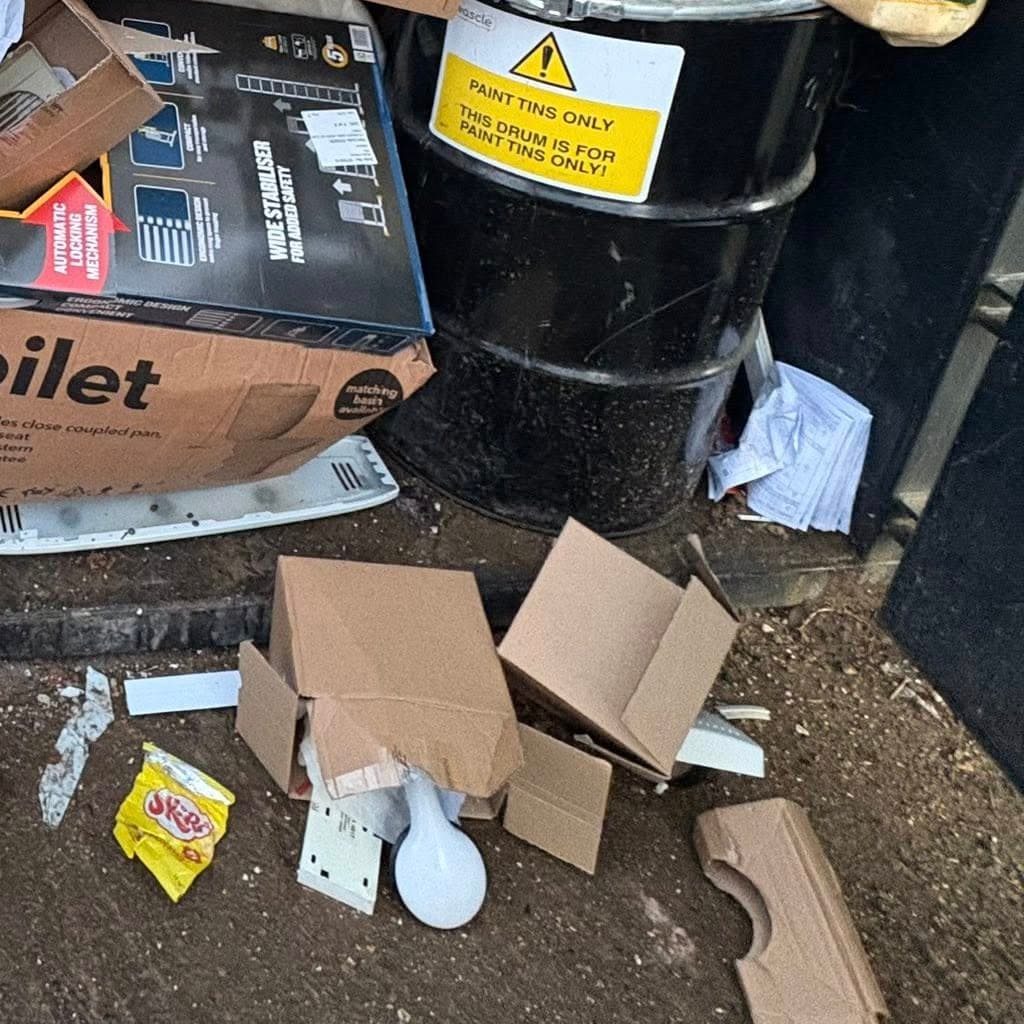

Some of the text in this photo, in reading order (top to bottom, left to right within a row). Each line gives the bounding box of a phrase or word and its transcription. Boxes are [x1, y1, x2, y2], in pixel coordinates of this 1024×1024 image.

[329, 49, 343, 63] 5
[469, 79, 615, 132] PAINT TINS ONLY
[459, 104, 616, 164] THIS DRUM IS FOR
[460, 120, 607, 177] PAINT TINS ONLY!
[253, 140, 289, 261] WIDE STABILISER
[277, 165, 305, 264] FOR ADDED SAFETY
[53, 202, 67, 275] AUTOMATIC
[70, 213, 83, 267] LOCKING
[86, 204, 99, 280] MECHANISM
[144, 301, 192, 312] DESIGN
[345, 384, 399, 400] matching
[352, 394, 384, 406] basin
[22, 420, 63, 432] close
[65, 424, 129, 437] coupled
